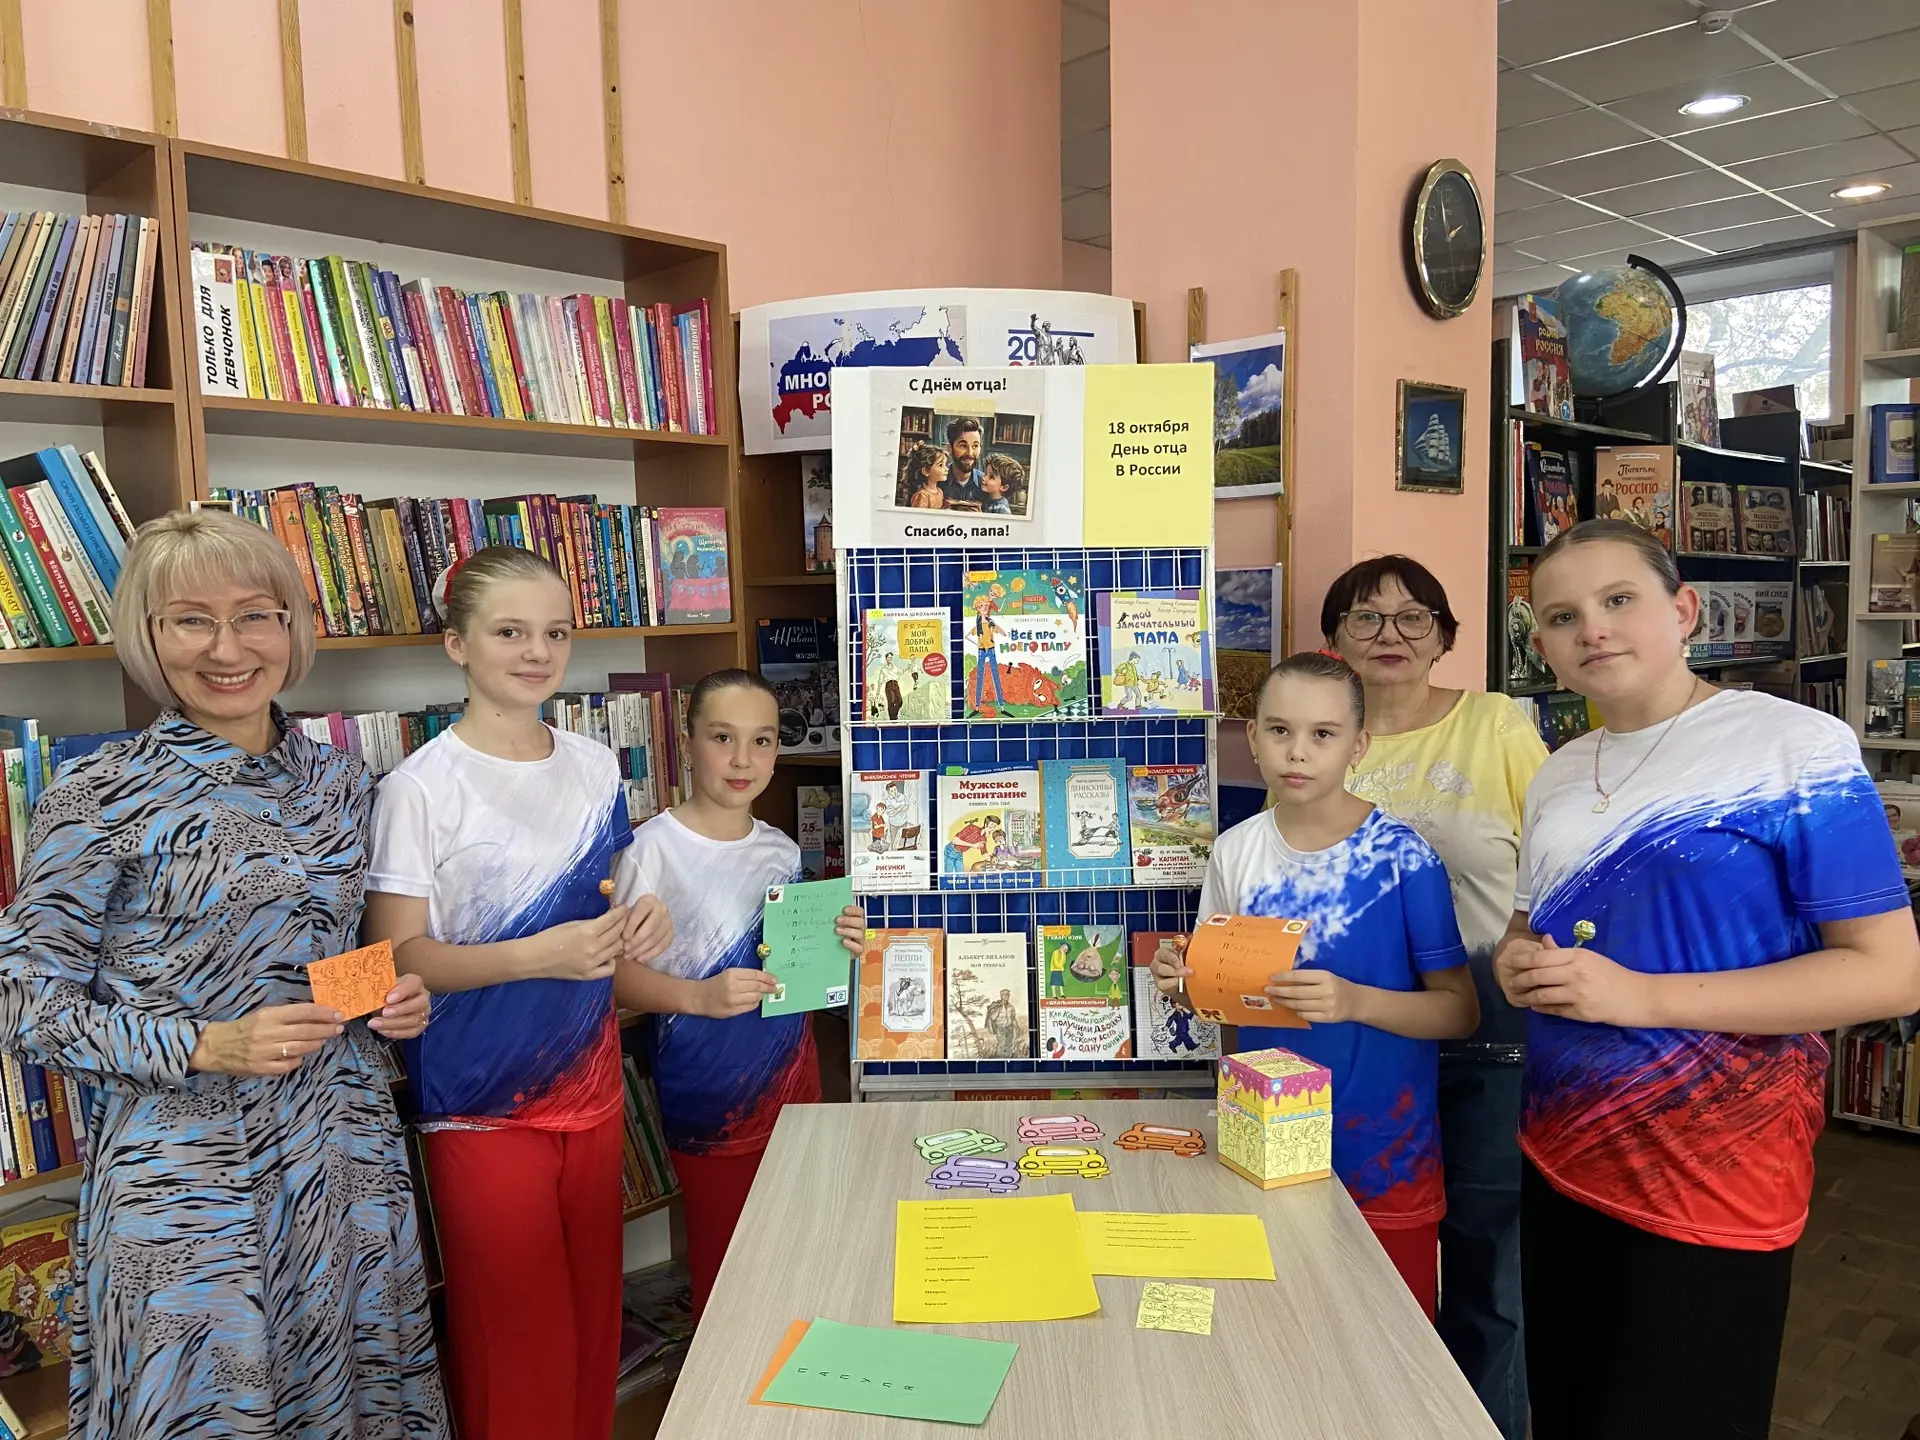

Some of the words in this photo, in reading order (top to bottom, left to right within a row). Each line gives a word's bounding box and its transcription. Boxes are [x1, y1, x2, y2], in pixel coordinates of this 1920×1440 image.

[200, 285, 214, 320] ДЛЯ
[202, 326, 218, 385] ТОЛЬКО
[220, 305, 238, 390] ДЕВЧОНОК
[1007, 335, 1038, 362] 20
[1535, 340, 1564, 356] РОССИЯ
[372, 349, 382, 372] ЛЮБВИ
[785, 372, 831, 390] МНО
[909, 379, 918, 392] С
[922, 376, 963, 395] Днём
[966, 378, 1007, 392] отца!
[1108, 421, 1126, 434] 18
[1129, 420, 1190, 436] октября
[1111, 442, 1149, 459] День
[1153, 442, 1188, 457] отца
[1116, 463, 1125, 477] В
[1129, 462, 1181, 478] России
[1615, 483, 1659, 495] РОССИЮ
[59, 513, 76, 540] БУДЕТ
[311, 521, 321, 544] волк
[904, 524, 968, 541] Спасибо,
[971, 525, 1010, 540] папа!
[350, 517, 364, 563] ПОСЛЕДНИЙ
[73, 540, 98, 581] МАЛОВАТО
[316, 545, 333, 591] Пчелиный
[46, 558, 72, 598] КАЛМЫКОВ
[341, 564, 353, 594] Лучшие
[1770, 590, 1788, 598] СЛЕД
[66, 599, 83, 623] ПАВЕЛ
[1132, 609, 1151, 621] МОЙ
[1116, 618, 1196, 629] ЗАМЕЧАТЕЛЬНЫЙ
[904, 638, 934, 646] ДОБРЫЙ
[1011, 629, 1032, 641] ВСЁ
[1036, 631, 1056, 640] ПРО
[1134, 631, 1179, 645] ПАПА
[1041, 642, 1071, 651] ПАПУ
[959, 781, 1019, 791] Мужское
[951, 790, 1027, 800] воспитание
[894, 953, 922, 962] ПЕППИ
[1052, 1020, 1092, 1032] ПОЛУЧИЛИ
[1078, 1044, 1100, 1052] ОДНУ
